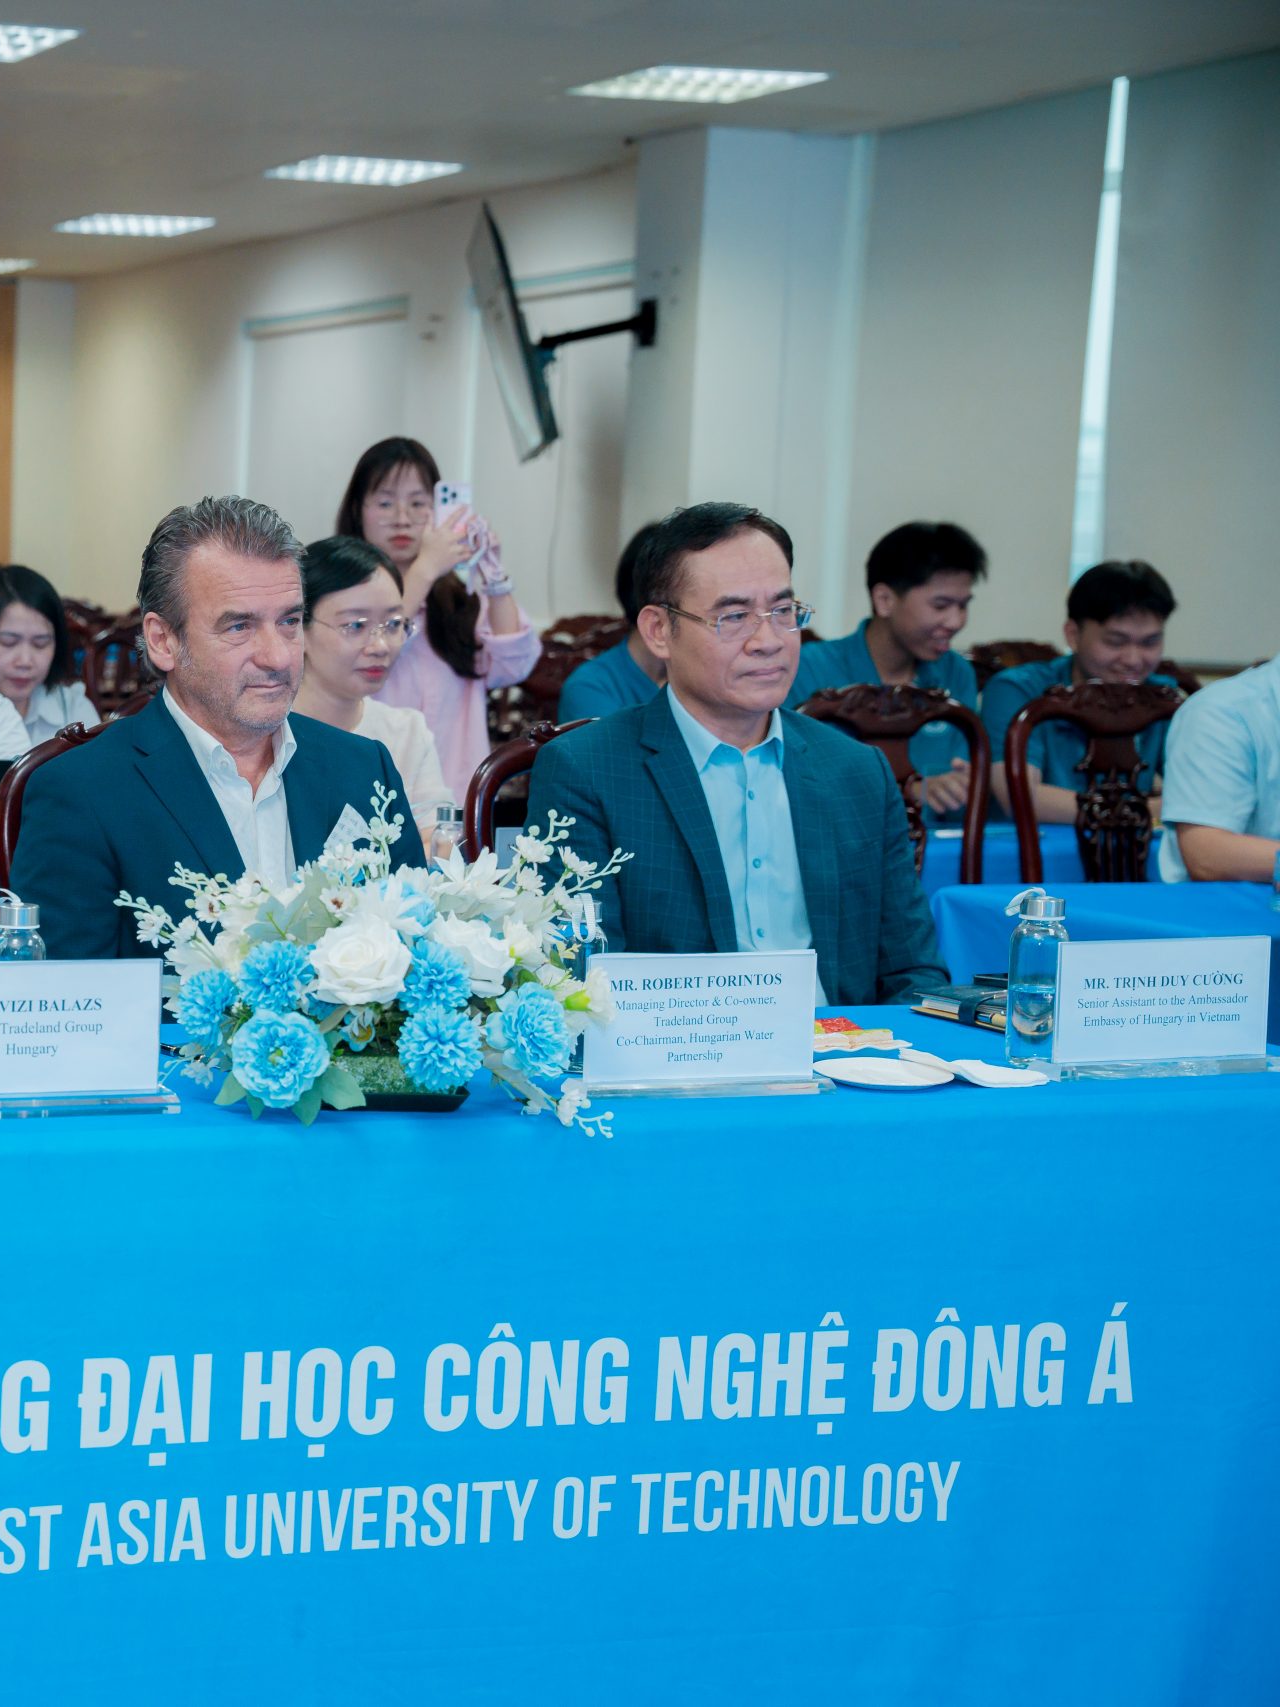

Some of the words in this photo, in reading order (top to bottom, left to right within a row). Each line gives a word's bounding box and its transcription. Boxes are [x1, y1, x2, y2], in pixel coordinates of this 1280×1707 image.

[610, 979, 638, 992] MR.
[642, 976, 703, 990] ROBERT
[707, 973, 782, 987] FORINTOS
[1084, 978, 1110, 990] MR.
[1113, 976, 1156, 991] TRỊNH
[1160, 975, 1189, 988] DUY
[1193, 970, 1243, 986] CƯỜNG
[0, 999, 33, 1012] VIZI
[38, 998, 102, 1012] BALAZS
[616, 1000, 665, 1012] Managing
[668, 998, 709, 1008] Director
[712, 997, 721, 1006] &
[724, 995, 776, 1007] Co-owner,
[1077, 998, 1109, 1009] Senior
[1112, 997, 1155, 1007] Assistant
[1158, 996, 1168, 1006] to
[1170, 995, 1185, 1005] the
[1188, 993, 1248, 1005] Ambassador
[1, 1021, 60, 1034] Tradeland
[64, 1020, 103, 1035] Group
[653, 1015, 703, 1027] Tradeland
[706, 1014, 738, 1026] Group
[1084, 1015, 1126, 1028] Embassy
[1129, 1014, 1140, 1025] of
[1143, 1013, 1183, 1026] Hungary
[1187, 1012, 1196, 1022] in
[1199, 1011, 1240, 1022] Vietnam
[616, 1035, 686, 1047] Co-Chairman,
[690, 1032, 741, 1045] Hungarian
[744, 1030, 774, 1041] Water
[6, 1043, 58, 1058] Hungary
[667, 1050, 723, 1063] Partnership
[77, 1353, 213, 1467] ĐẠI
[240, 1345, 395, 1458] HỌC
[423, 1322, 630, 1432] CÔNG
[654, 1312, 850, 1434] NGHỆ
[872, 1307, 1069, 1413] ĐÔNG
[1088, 1301, 1134, 1404] Á
[77, 1497, 206, 1568] ASIA
[223, 1478, 538, 1559] UNIVERSITY
[552, 1475, 617, 1539] OF
[630, 1460, 962, 1535] TECHNOLOGY
